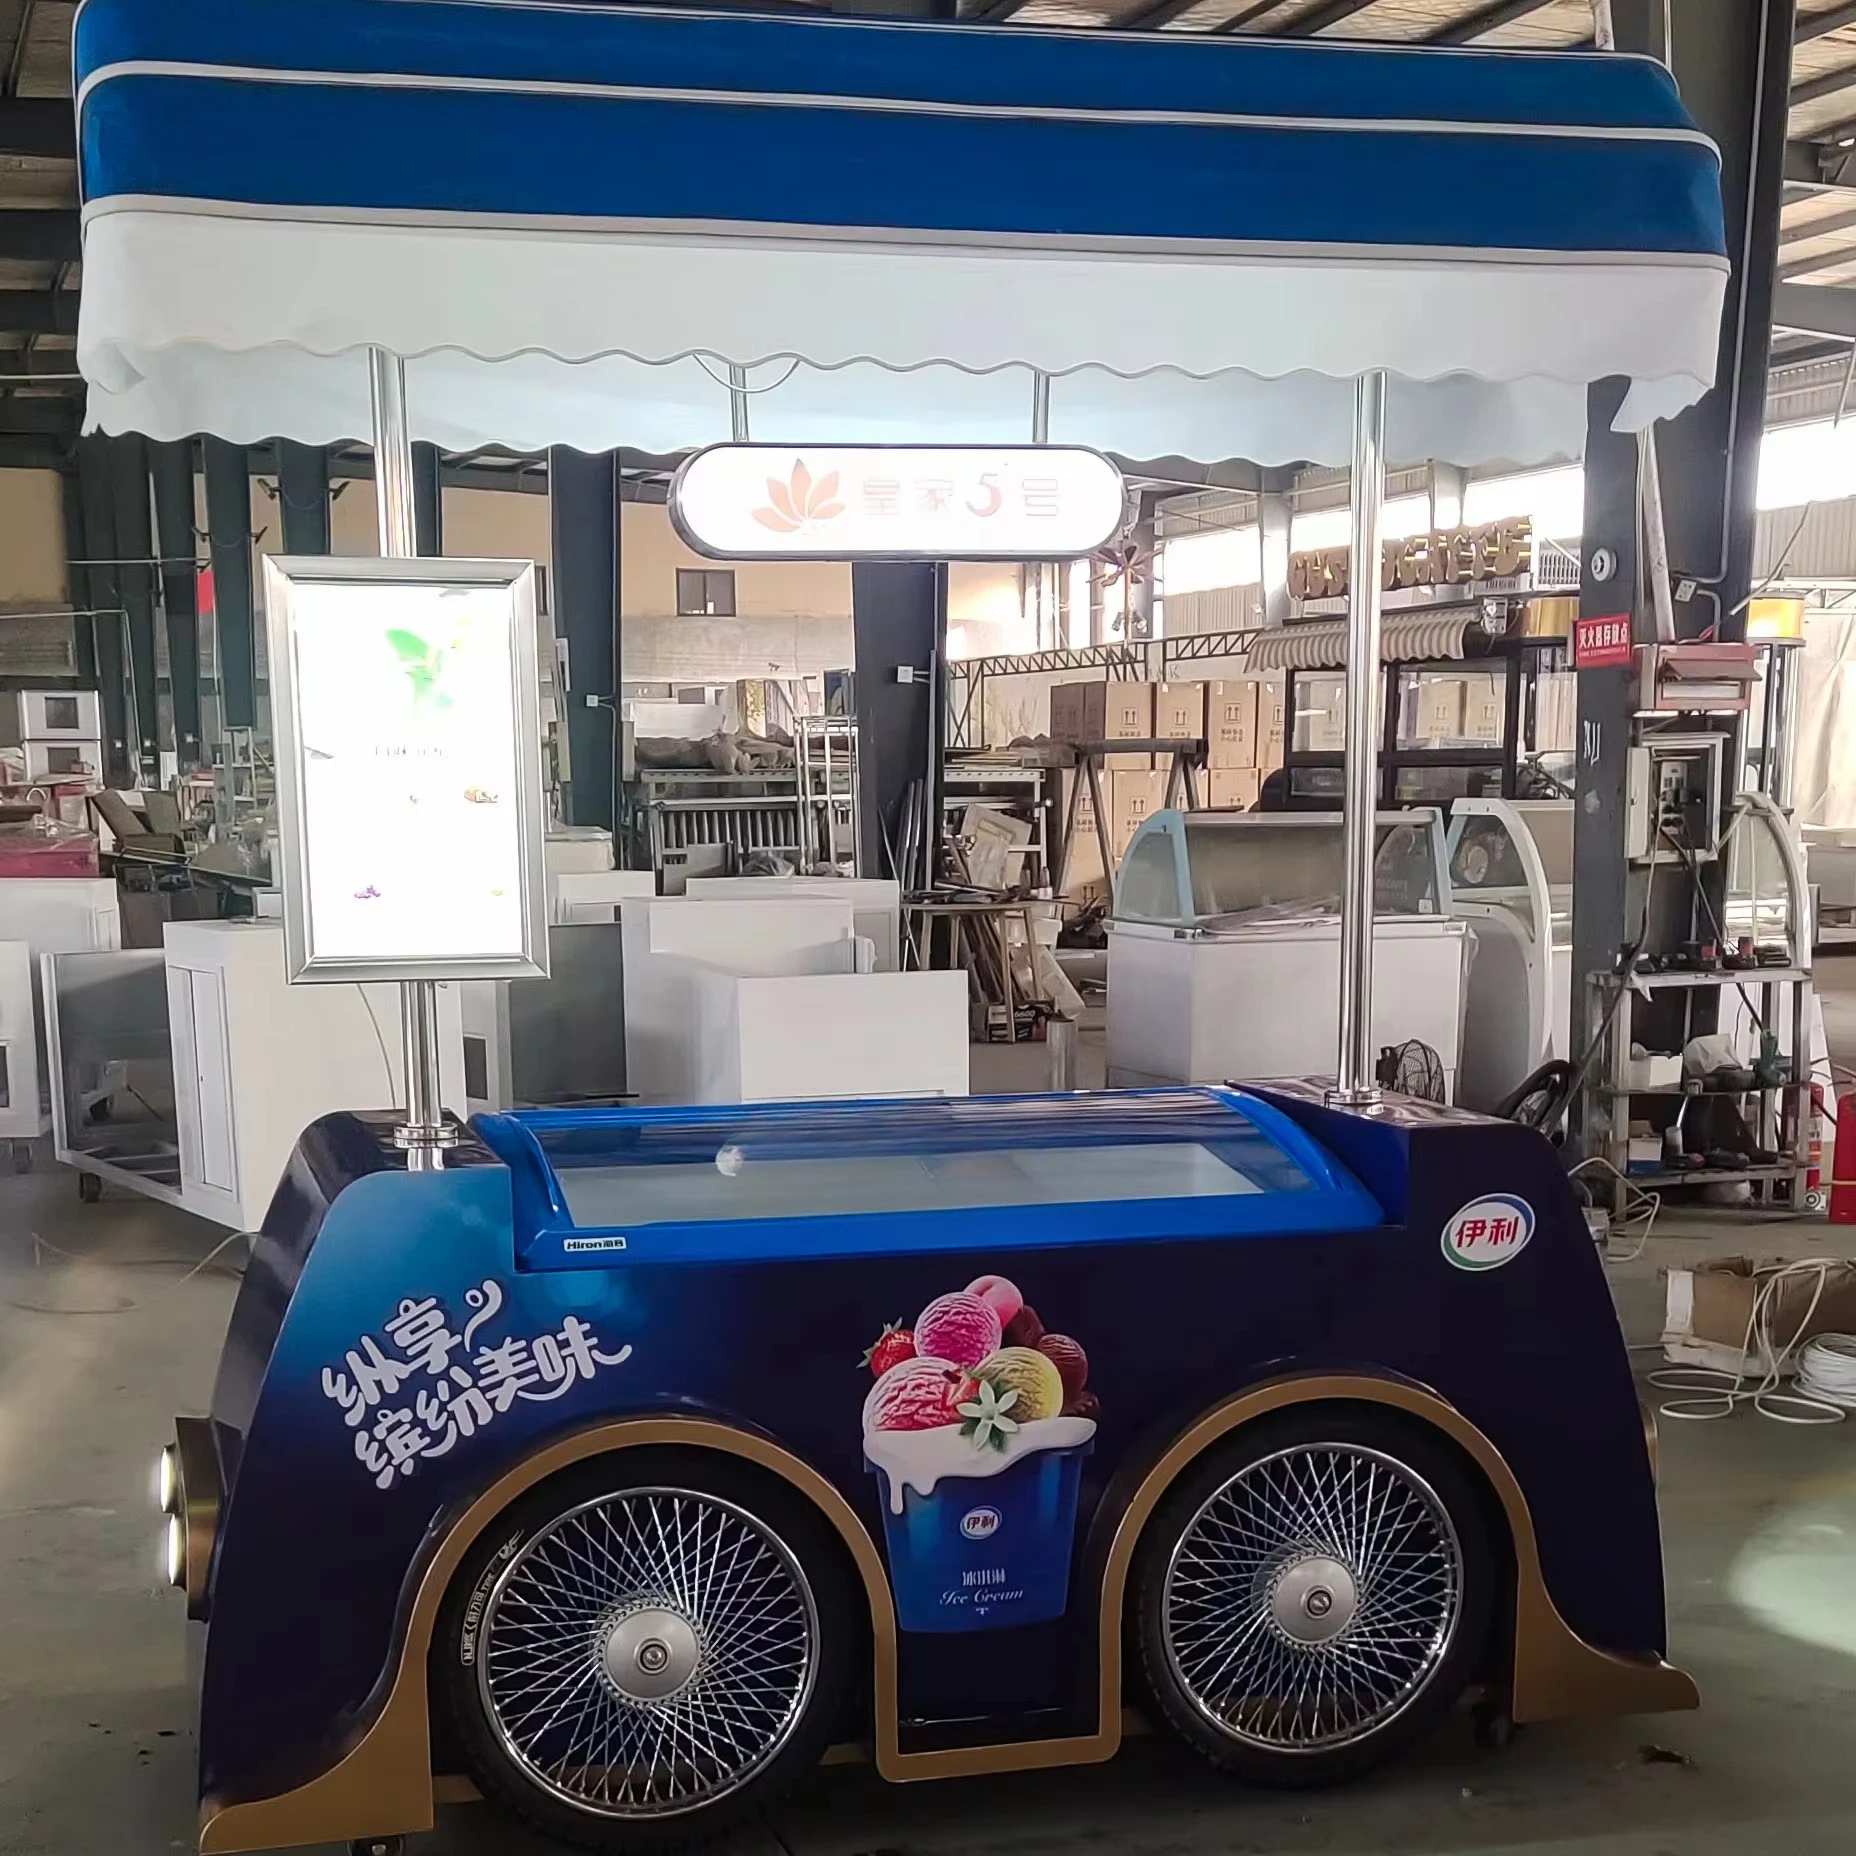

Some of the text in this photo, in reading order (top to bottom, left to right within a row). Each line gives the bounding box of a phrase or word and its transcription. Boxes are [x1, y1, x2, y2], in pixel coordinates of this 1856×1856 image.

[1456, 1216, 1519, 1248] 伊利
[966, 1515, 995, 1529] 伊利
[939, 1590, 968, 1605] Ice
